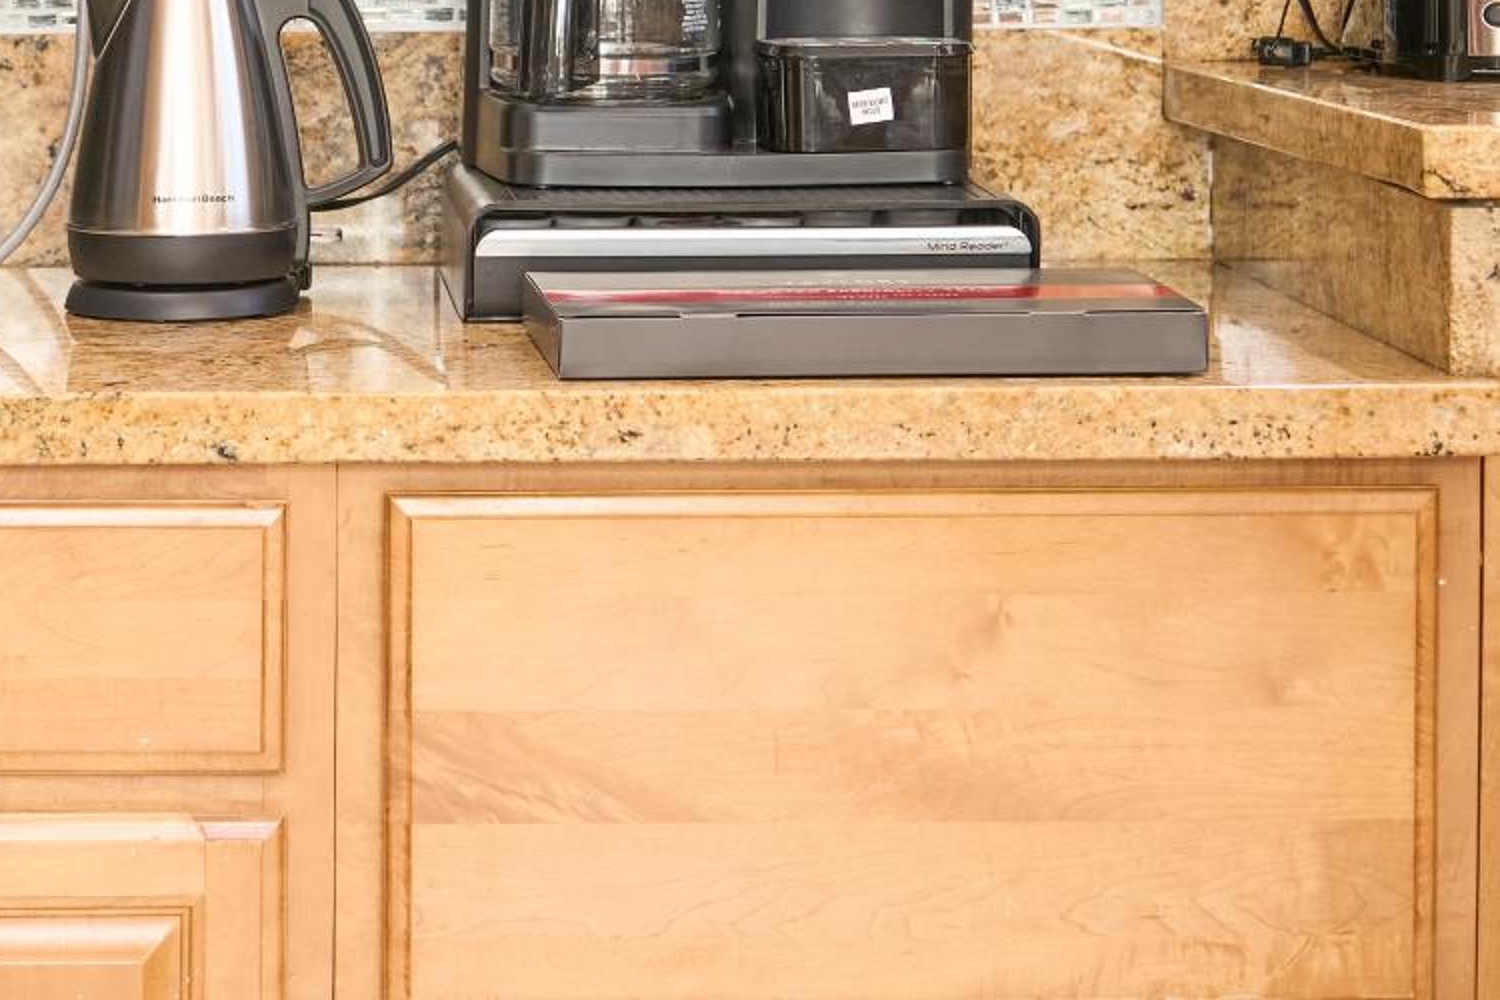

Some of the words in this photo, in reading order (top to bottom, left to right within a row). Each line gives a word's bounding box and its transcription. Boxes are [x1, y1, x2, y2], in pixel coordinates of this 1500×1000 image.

[152, 194, 235, 204] HamnBeach
[928, 242, 957, 251] Mind
[960, 242, 1003, 251] Reader
